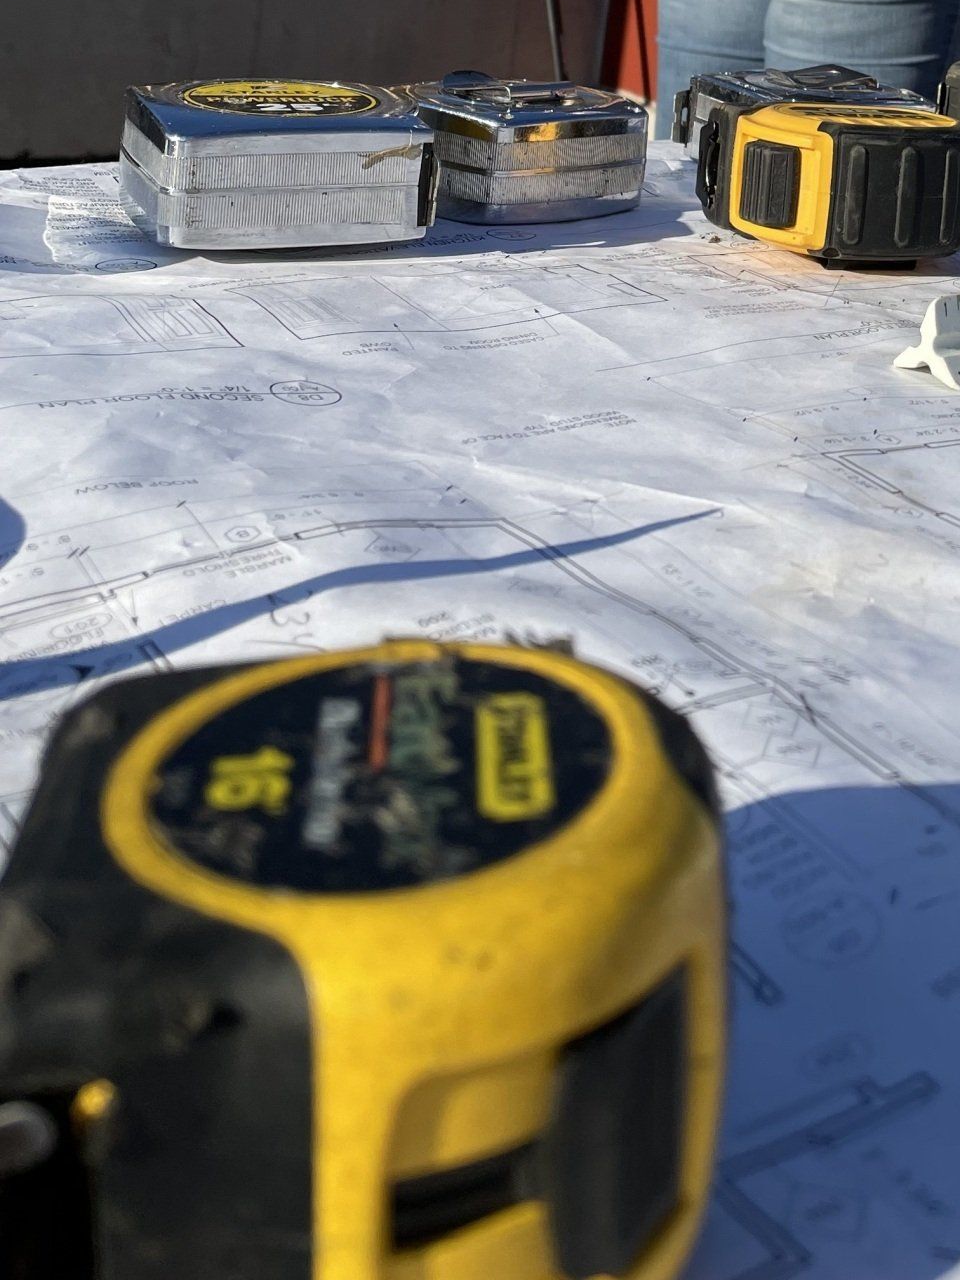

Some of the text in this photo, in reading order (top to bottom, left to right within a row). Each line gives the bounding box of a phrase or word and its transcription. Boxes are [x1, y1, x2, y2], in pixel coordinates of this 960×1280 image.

[179, 393, 265, 403] SECOND
[74, 478, 199, 496] ROOF BELOW
